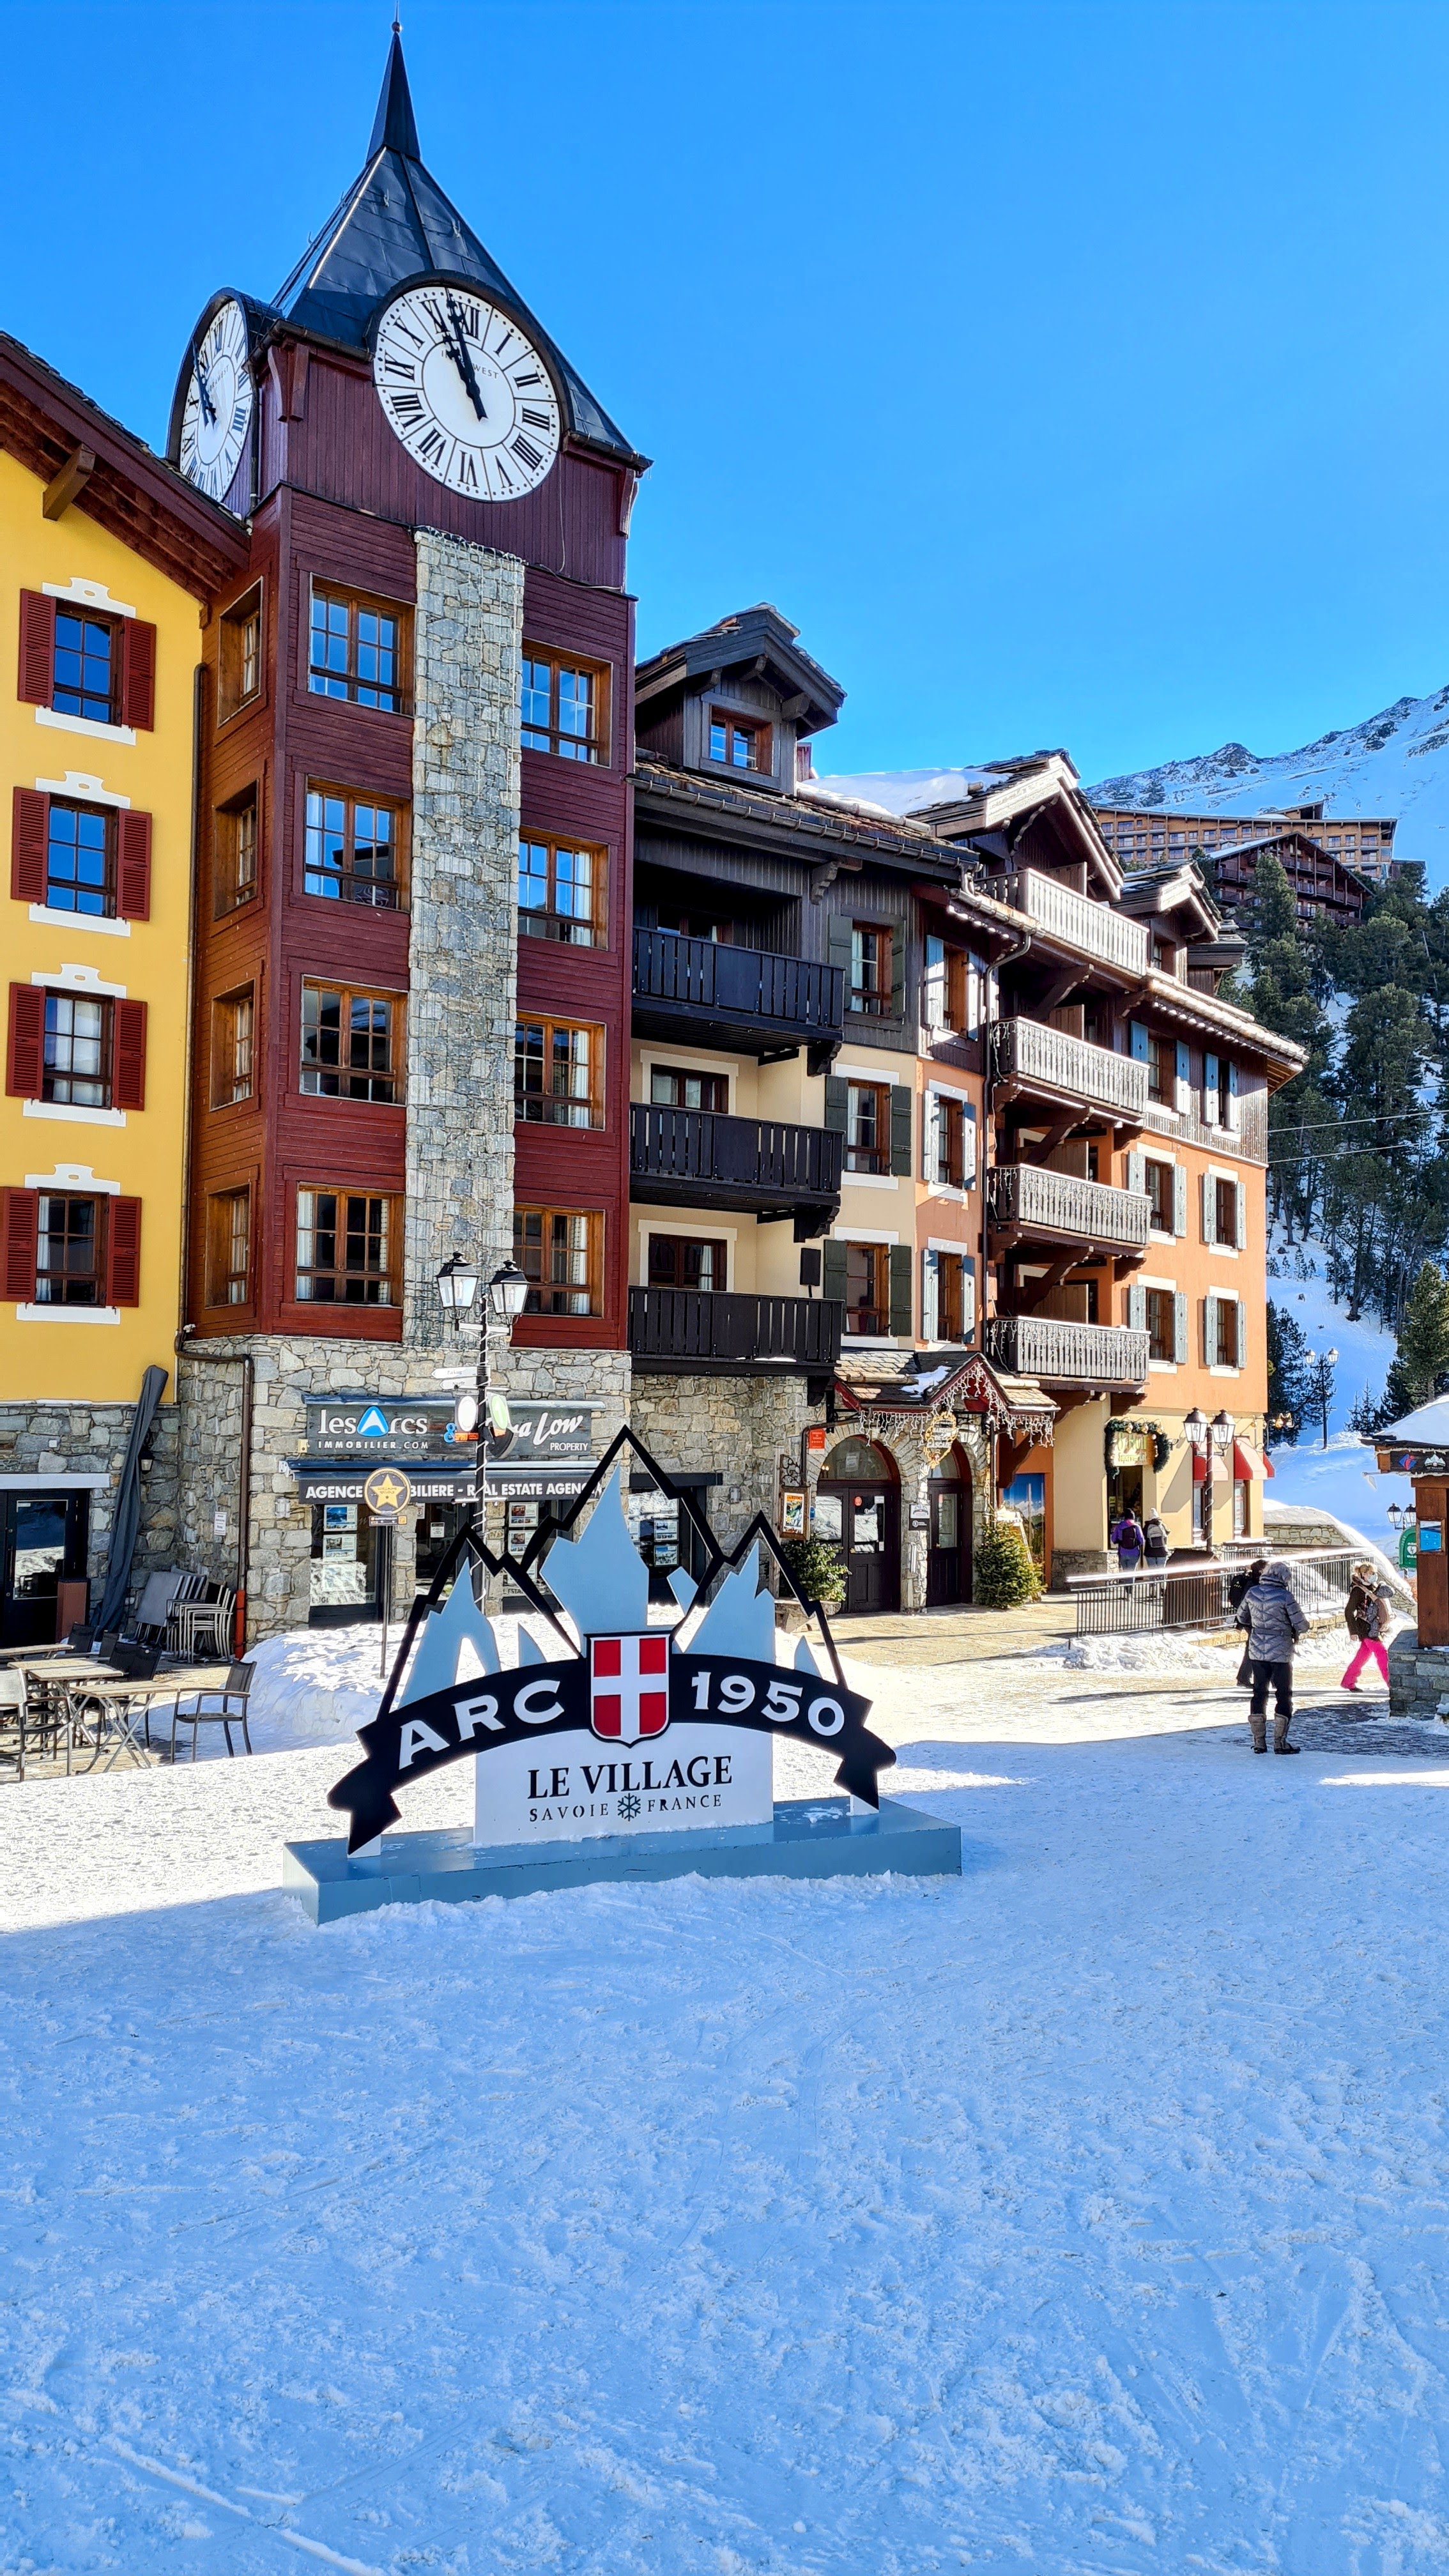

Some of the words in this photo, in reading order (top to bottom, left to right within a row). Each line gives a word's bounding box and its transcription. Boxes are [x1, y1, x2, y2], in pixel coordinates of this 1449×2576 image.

[392, 315, 425, 351] X
[494, 330, 514, 357] I
[384, 351, 415, 383] IX
[512, 369, 543, 390] II
[388, 392, 426, 432] VIII
[521, 405, 551, 432] III
[415, 425, 447, 469] VII
[509, 432, 545, 472] IIII
[458, 450, 480, 488] VI
[494, 455, 516, 489] V
[318, 1441, 429, 1450] IMMOBILIER.COM
[532, 1412, 584, 1446] Low
[549, 1442, 588, 1452] PROPERTY
[305, 1485, 364, 1499] AGENCE
[410, 1484, 454, 1497] BILIERE
[467, 1484, 498, 1496] RAL
[502, 1483, 542, 1495] ESTATE
[546, 1482, 588, 1495] AGEN
[399, 1679, 565, 1770] ARC
[691, 1671, 845, 1736] 1950
[527, 1767, 570, 1799] LE
[579, 1756, 732, 1794] VILLAGE
[530, 1803, 609, 1822] SAVOIE
[648, 1794, 722, 1813] FRANCE
